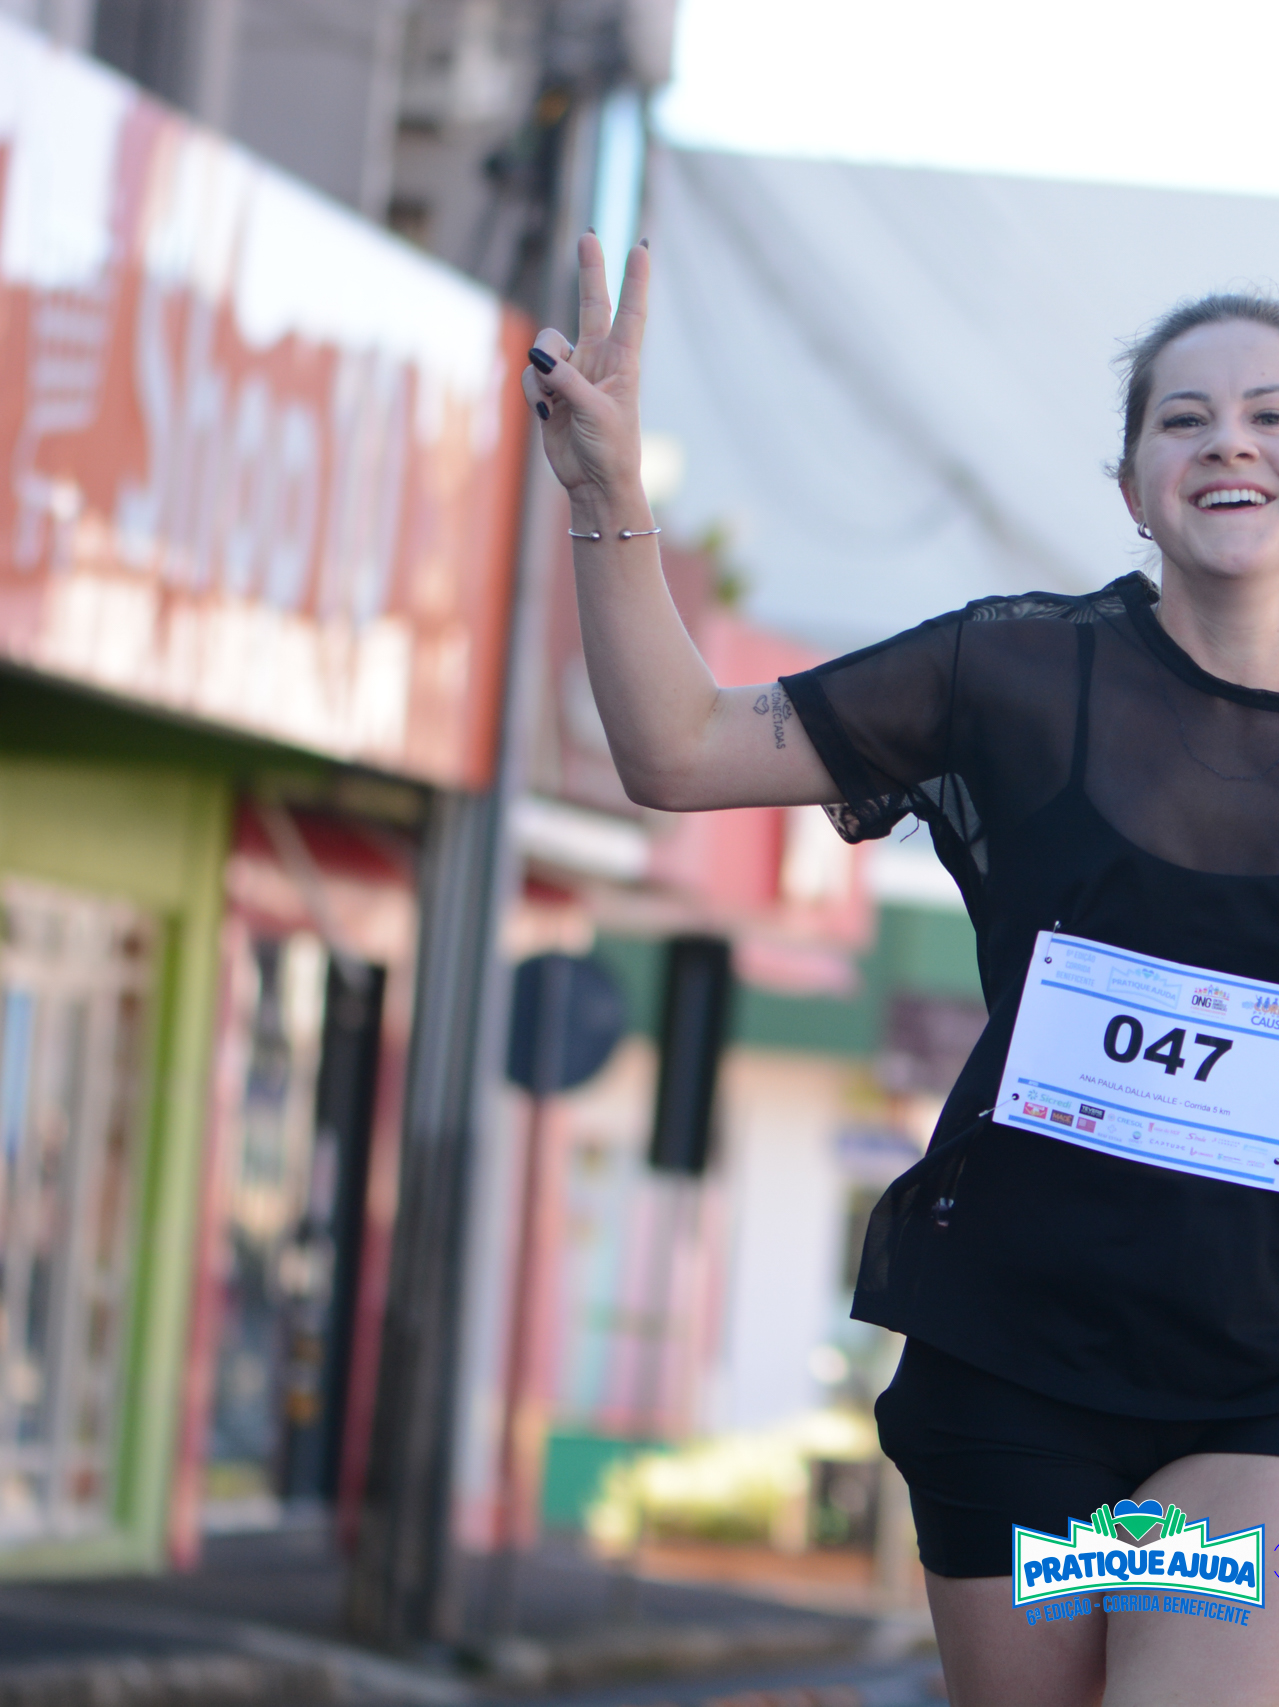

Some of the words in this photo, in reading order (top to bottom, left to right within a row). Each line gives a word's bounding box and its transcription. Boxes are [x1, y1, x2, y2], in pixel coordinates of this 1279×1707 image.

[1065, 961, 1091, 973] CORRIDA
[1056, 970, 1095, 987] BENEFICENTE
[1112, 978, 1152, 992] PRATIQUE
[1151, 987, 1176, 1001] AJUDA
[1191, 994, 1212, 1008] ONG
[1103, 1014, 1233, 1082] 047
[1040, 1092, 1072, 1109] Sicredi
[1079, 1074, 1096, 1084] ANA
[1098, 1078, 1123, 1092] PAULA
[1125, 1086, 1151, 1099] DALLA
[1153, 1093, 1177, 1105] VALLE
[1184, 1100, 1211, 1112] Corrida
[1212, 1106, 1218, 1114] 5
[1219, 1108, 1230, 1116] km
[1117, 1116, 1143, 1128] CRESOL
